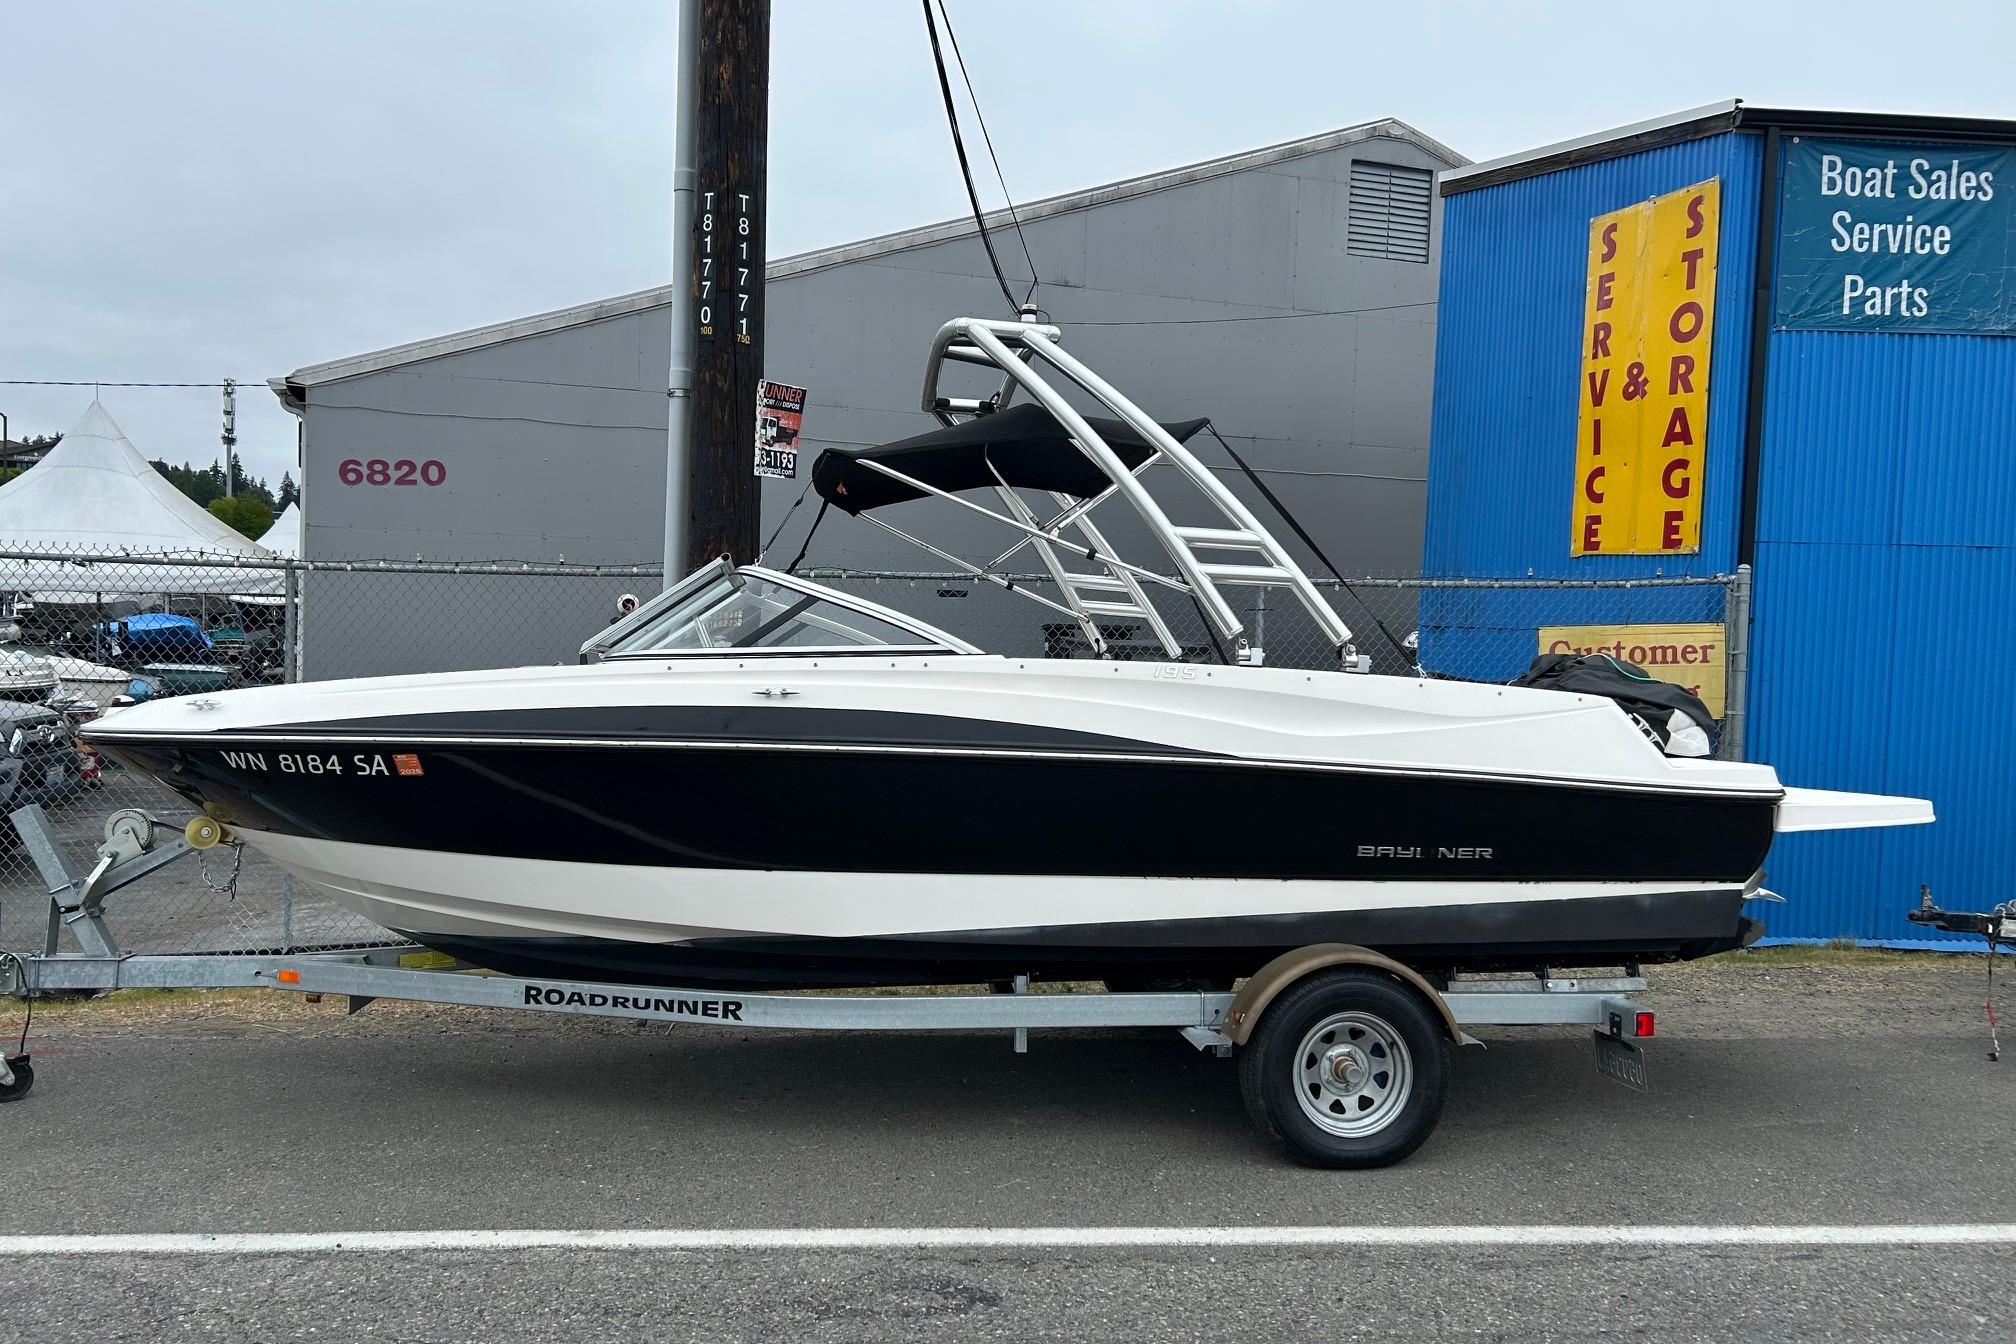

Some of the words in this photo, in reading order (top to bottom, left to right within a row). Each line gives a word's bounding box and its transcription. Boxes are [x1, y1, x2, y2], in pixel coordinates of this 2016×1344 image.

[1821, 153, 1899, 200] Boat
[1908, 158, 1994, 202] Sales
[1831, 211, 1952, 255] Service
[701, 192, 714, 324] T81770
[738, 194, 750, 335] T81771
[1843, 274, 1930, 318] Parts
[700, 326, 713, 335] 100
[1583, 222, 1618, 552] SERVICE
[1622, 362, 1650, 402] &
[1661, 194, 1706, 550] STORAGE
[765, 383, 803, 403] UNNER
[339, 459, 446, 486] 6820
[758, 450, 794, 469] 3-1193
[1154, 665, 1197, 680] 195
[219, 751, 268, 771] WN
[279, 754, 343, 775] 8184
[354, 755, 390, 776] SA
[1357, 845, 1494, 859] BAYLNER
[524, 985, 744, 1022] ROADRUNNER
